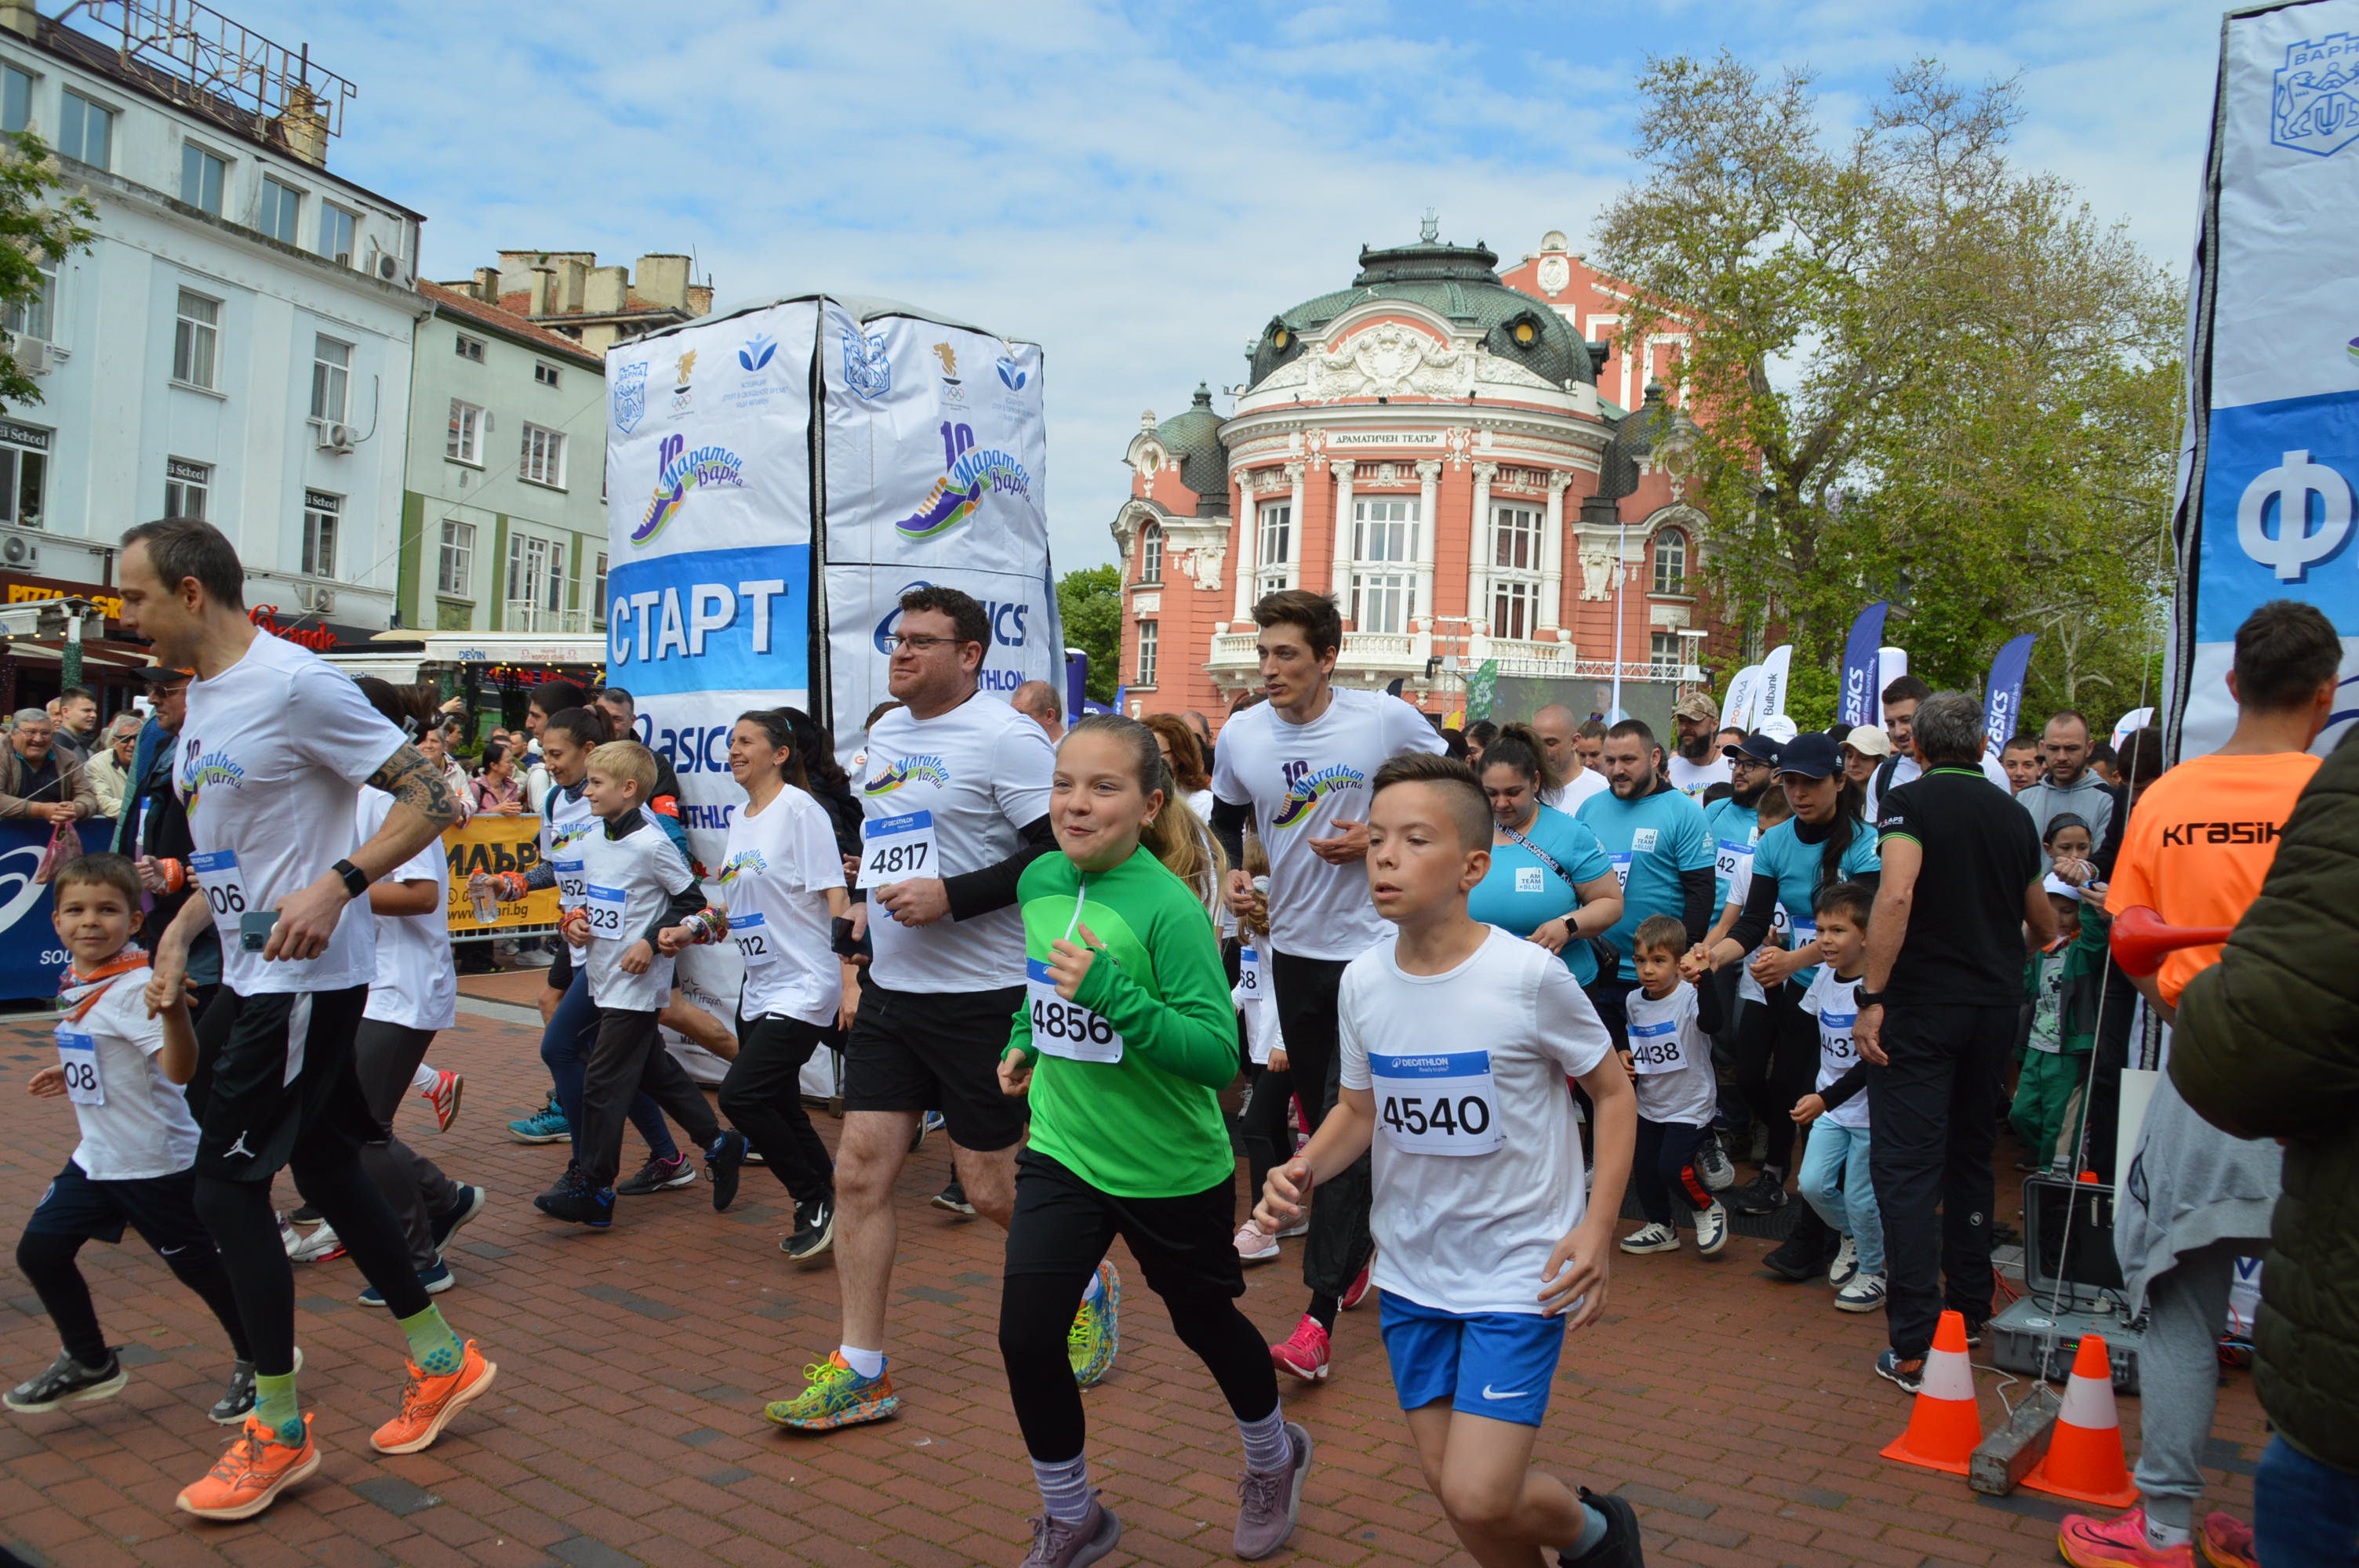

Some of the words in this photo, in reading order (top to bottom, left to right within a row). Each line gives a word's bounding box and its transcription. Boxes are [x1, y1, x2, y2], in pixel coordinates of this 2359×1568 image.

[11, 428, 46, 446] School
[940, 420, 975, 474] 10
[1336, 434, 1398, 444] ДРАМАТИЧЕН
[1401, 434, 1438, 443] ТЕАТЪР
[176, 464, 205, 481] School
[659, 434, 684, 483] 10
[663, 446, 743, 493] Маратон
[954, 449, 1030, 492] Маратон
[693, 463, 743, 488] Варна
[990, 466, 1030, 503] Варна
[313, 495, 337, 510] School
[612, 579, 787, 665] СТАРТ
[1763, 673, 1778, 716] Bulbank
[184, 750, 245, 782] Marathon
[203, 769, 242, 790] Varna
[896, 755, 950, 782] Marathon
[916, 768, 943, 789] Varna
[1281, 760, 1308, 792] 10
[1293, 764, 1365, 797] Marathon
[1325, 779, 1363, 793] Varna
[888, 817, 914, 827] DECATHLON
[732, 848, 767, 869] Marathon
[870, 842, 928, 873] 4817
[1033, 999, 1114, 1044] 4856
[64, 1062, 96, 1091] 08
[1402, 1058, 1449, 1067] DECATHLON
[1383, 1095, 1490, 1136] 4540
